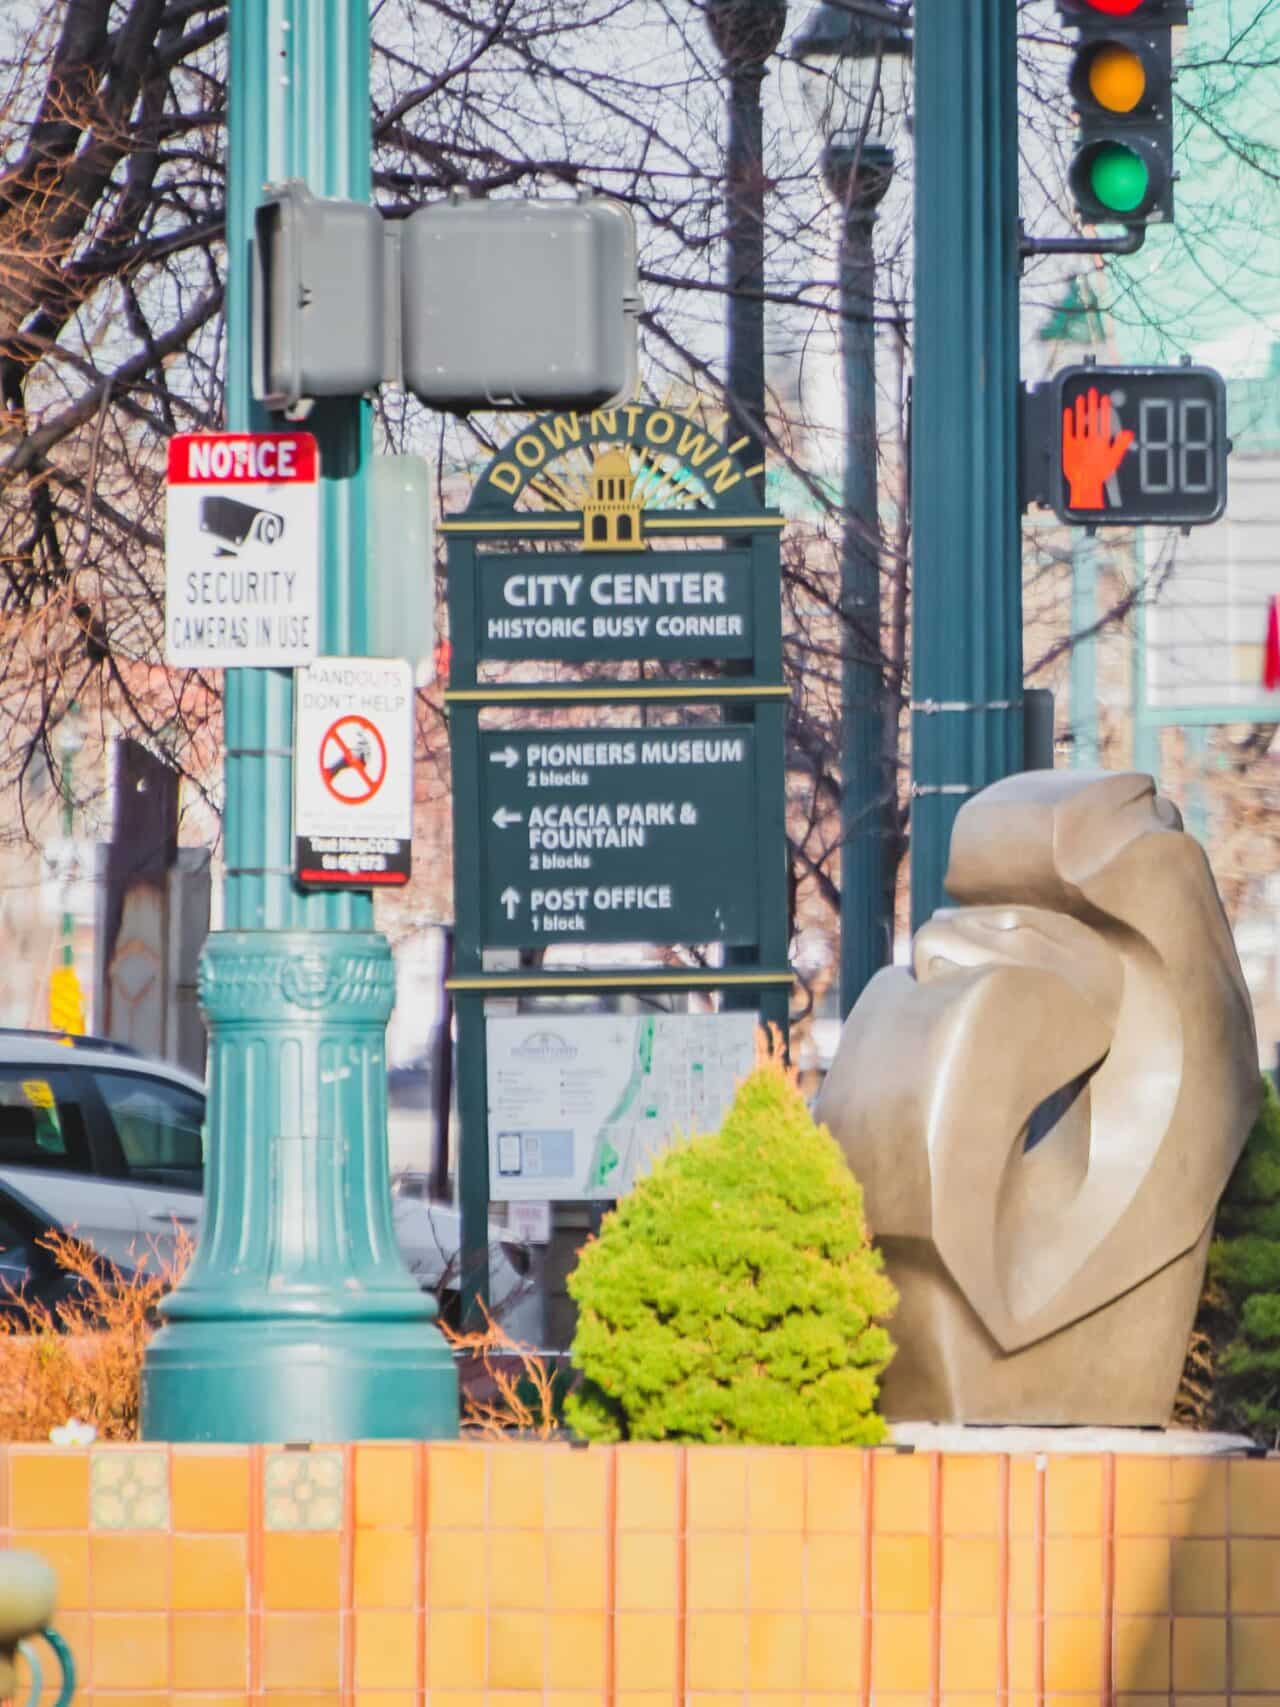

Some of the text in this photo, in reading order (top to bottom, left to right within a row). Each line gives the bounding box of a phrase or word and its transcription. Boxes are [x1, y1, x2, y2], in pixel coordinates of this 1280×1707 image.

[188, 440, 297, 479] NOTICE
[488, 405, 742, 495] DOWNTOWN
[186, 571, 297, 605] SECURITY
[503, 571, 726, 606] CITY CENTER
[172, 615, 312, 648] CAMERAS IN USE
[487, 614, 744, 640] HISTORIC BUSY CORNER
[302, 693, 406, 713] DON'T HELP
[526, 739, 745, 767] PIONEERS MUSEUM
[527, 770, 590, 787] 2 blocks
[528, 802, 698, 829] ACACIA PARK &
[528, 826, 646, 850] FOUNTAIN
[530, 853, 592, 871] 2 blocks
[530, 884, 672, 912] POST OFFICE
[531, 914, 586, 932] 1 block
